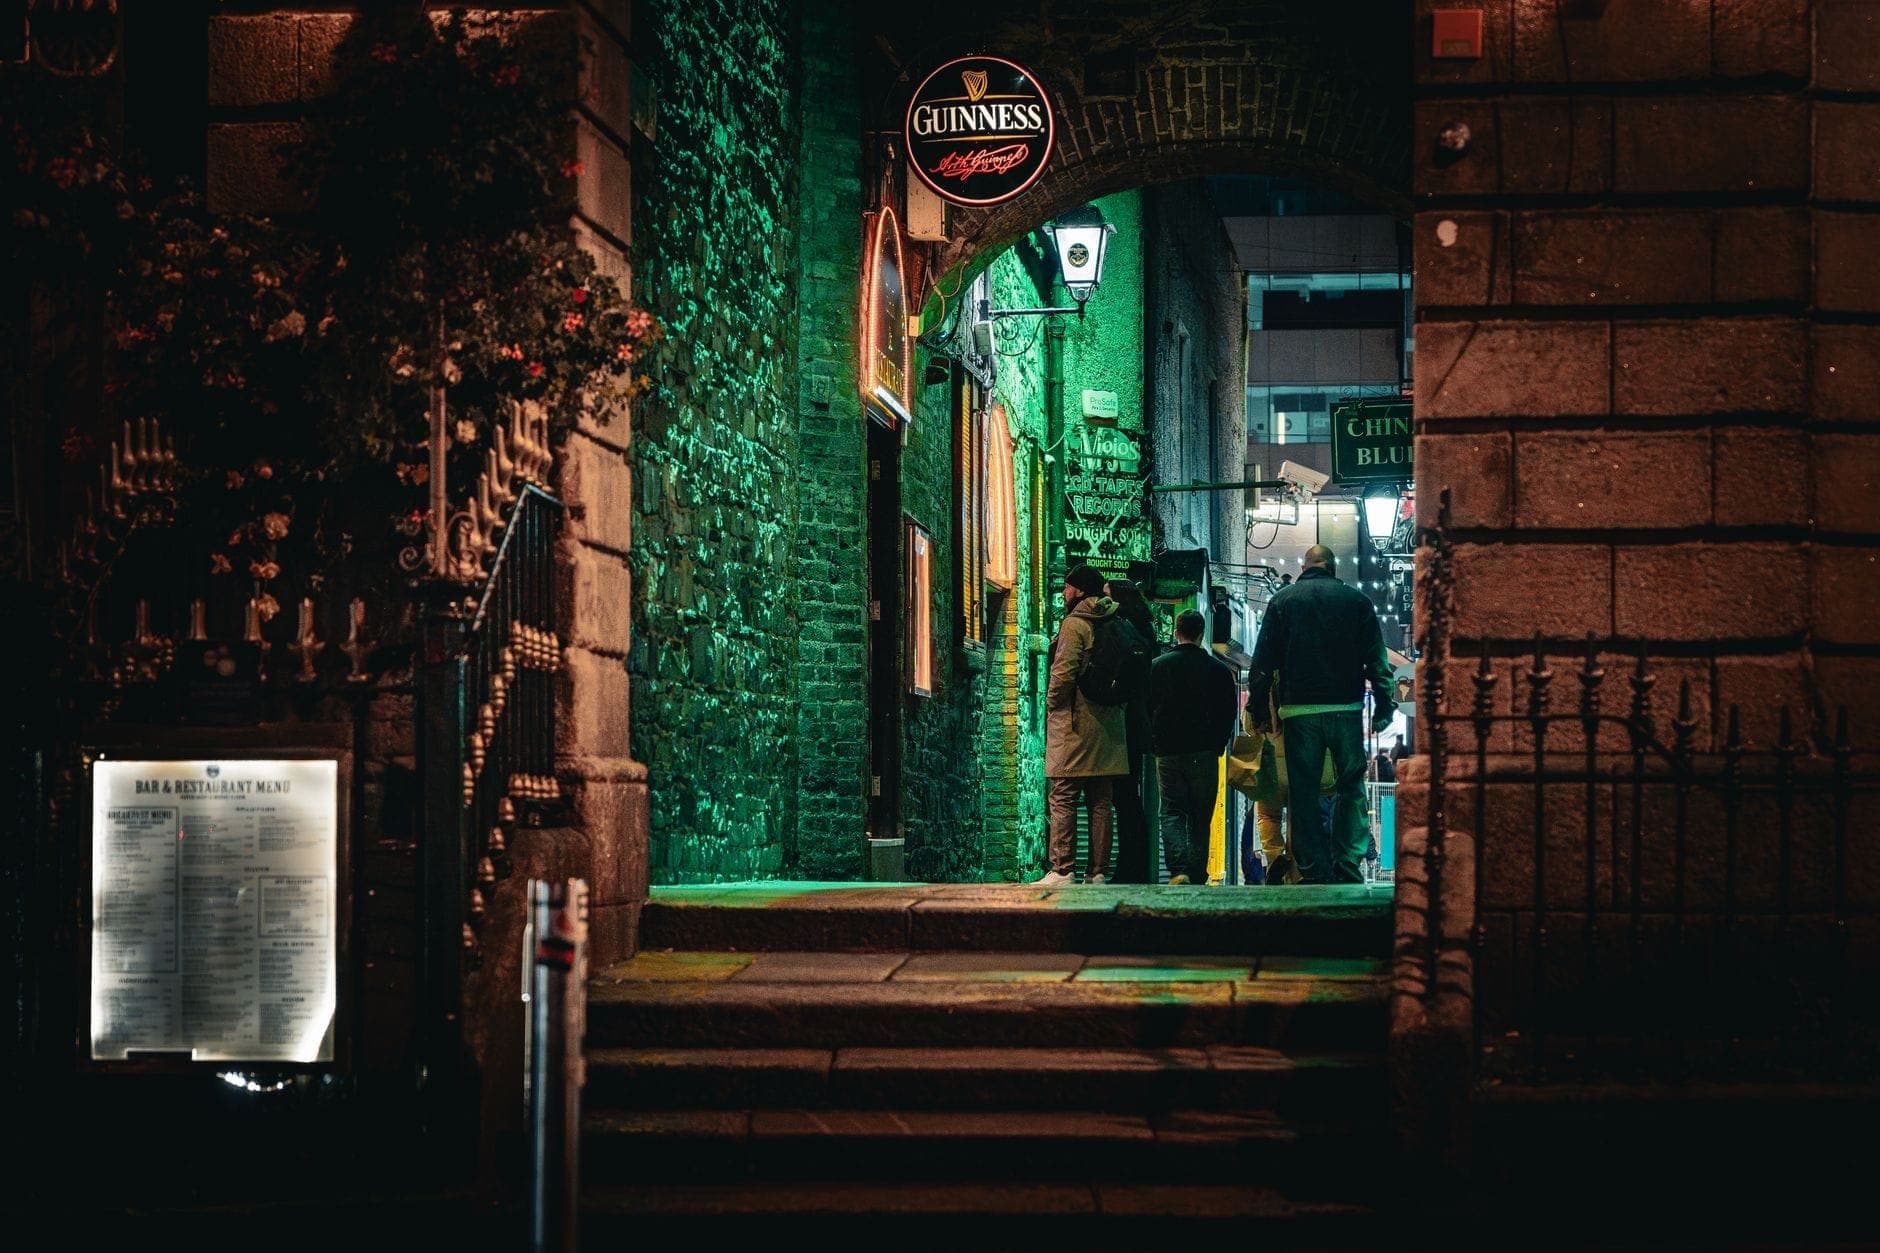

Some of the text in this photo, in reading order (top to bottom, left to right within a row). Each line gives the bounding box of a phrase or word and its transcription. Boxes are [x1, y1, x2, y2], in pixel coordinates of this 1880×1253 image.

[1347, 417, 1414, 437] CHIN
[1096, 477, 1143, 498] TAPES
[1073, 495, 1141, 517] RECORDS
[135, 780, 290, 794] BAR & RESTAURANT MENU
